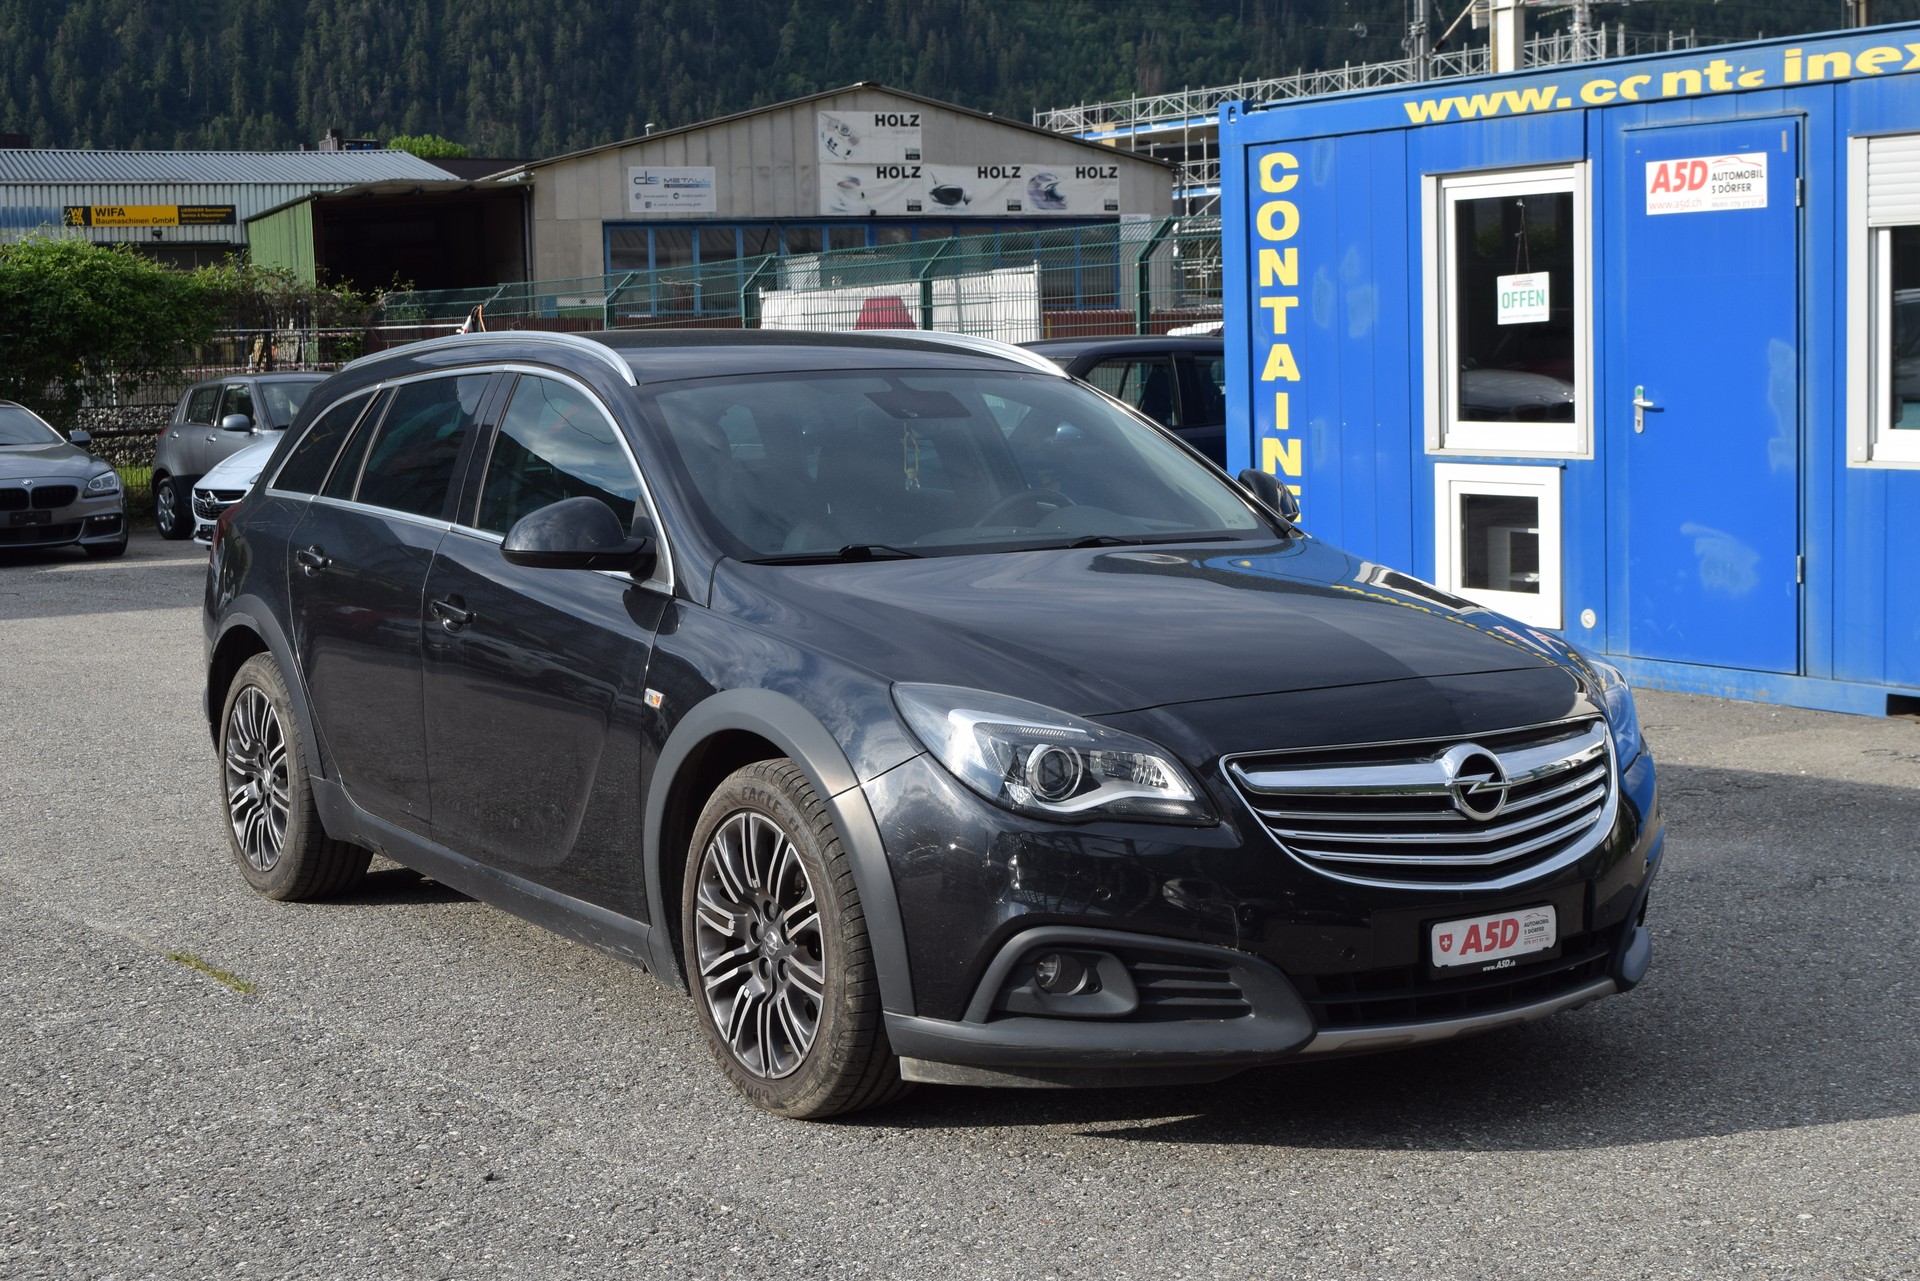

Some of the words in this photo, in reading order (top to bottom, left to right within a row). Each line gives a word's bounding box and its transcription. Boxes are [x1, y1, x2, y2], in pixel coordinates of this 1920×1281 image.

[875, 114, 920, 127] HOLZ
[877, 166, 921, 179] HOLZ
[978, 166, 1021, 179] HOLZ
[1076, 166, 1118, 179] HOLZ
[1650, 160, 1708, 194] A5D
[1711, 169, 1764, 182] AUTOMOBIL
[1711, 185, 1716, 194] 5
[1718, 182, 1752, 194] DÖRFER
[1649, 198, 1702, 210] www.a5d.ch
[95, 208, 125, 217] WIFA
[1502, 289, 1545, 309] OFFEN
[741, 787, 782, 814] EAGLE
[1524, 919, 1549, 927] AUTOMOBIL
[1528, 926, 1544, 934] DÖRFER
[1459, 918, 1520, 956] A5D
[1482, 959, 1516, 971] www.A5D.ch
